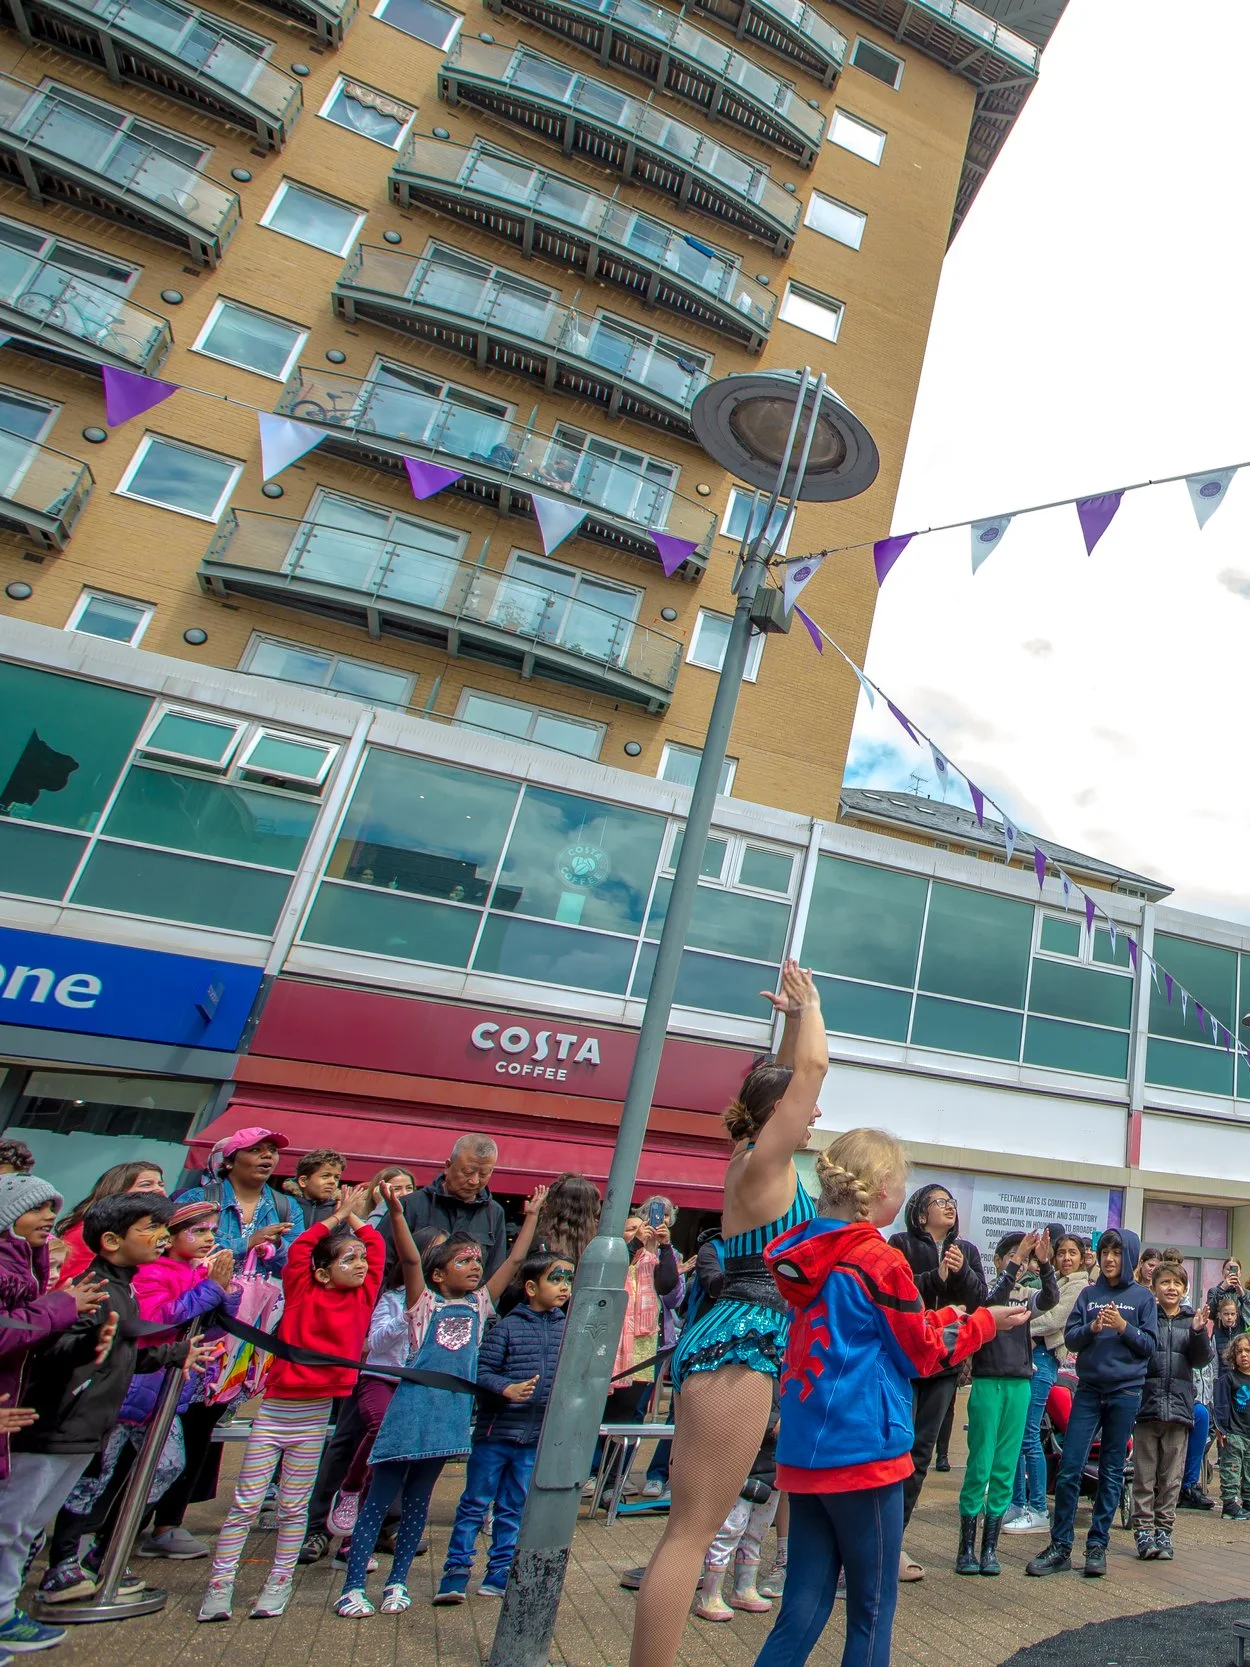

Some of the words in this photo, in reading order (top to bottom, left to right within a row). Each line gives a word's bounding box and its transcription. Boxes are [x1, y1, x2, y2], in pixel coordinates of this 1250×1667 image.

[568, 846, 602, 860] COSTA
[561, 866, 602, 885] COFFEE
[0, 962, 102, 1009] ne
[471, 1021, 600, 1065] COSTA
[495, 1061, 568, 1081] COFFEE
[1026, 1196, 1040, 1205] ARTS
[1041, 1198, 1047, 1206] IS
[1047, 1198, 1079, 1209] COMMITTED
[1079, 1201, 1087, 1210] TO
[983, 1204, 1010, 1214] WORKING
[1010, 1207, 1025, 1216] WITH
[1025, 1208, 1056, 1219] VOLUNTARY
[1057, 1212, 1068, 1220] AND
[1068, 1213, 1098, 1223] STATUTORY
[981, 1216, 1025, 1228] ORGANISATIONS
[1026, 1220, 1032, 1229] IN
[1065, 1224, 1072, 1232] TO
[1087, 1301, 1136, 1311] Chaion
